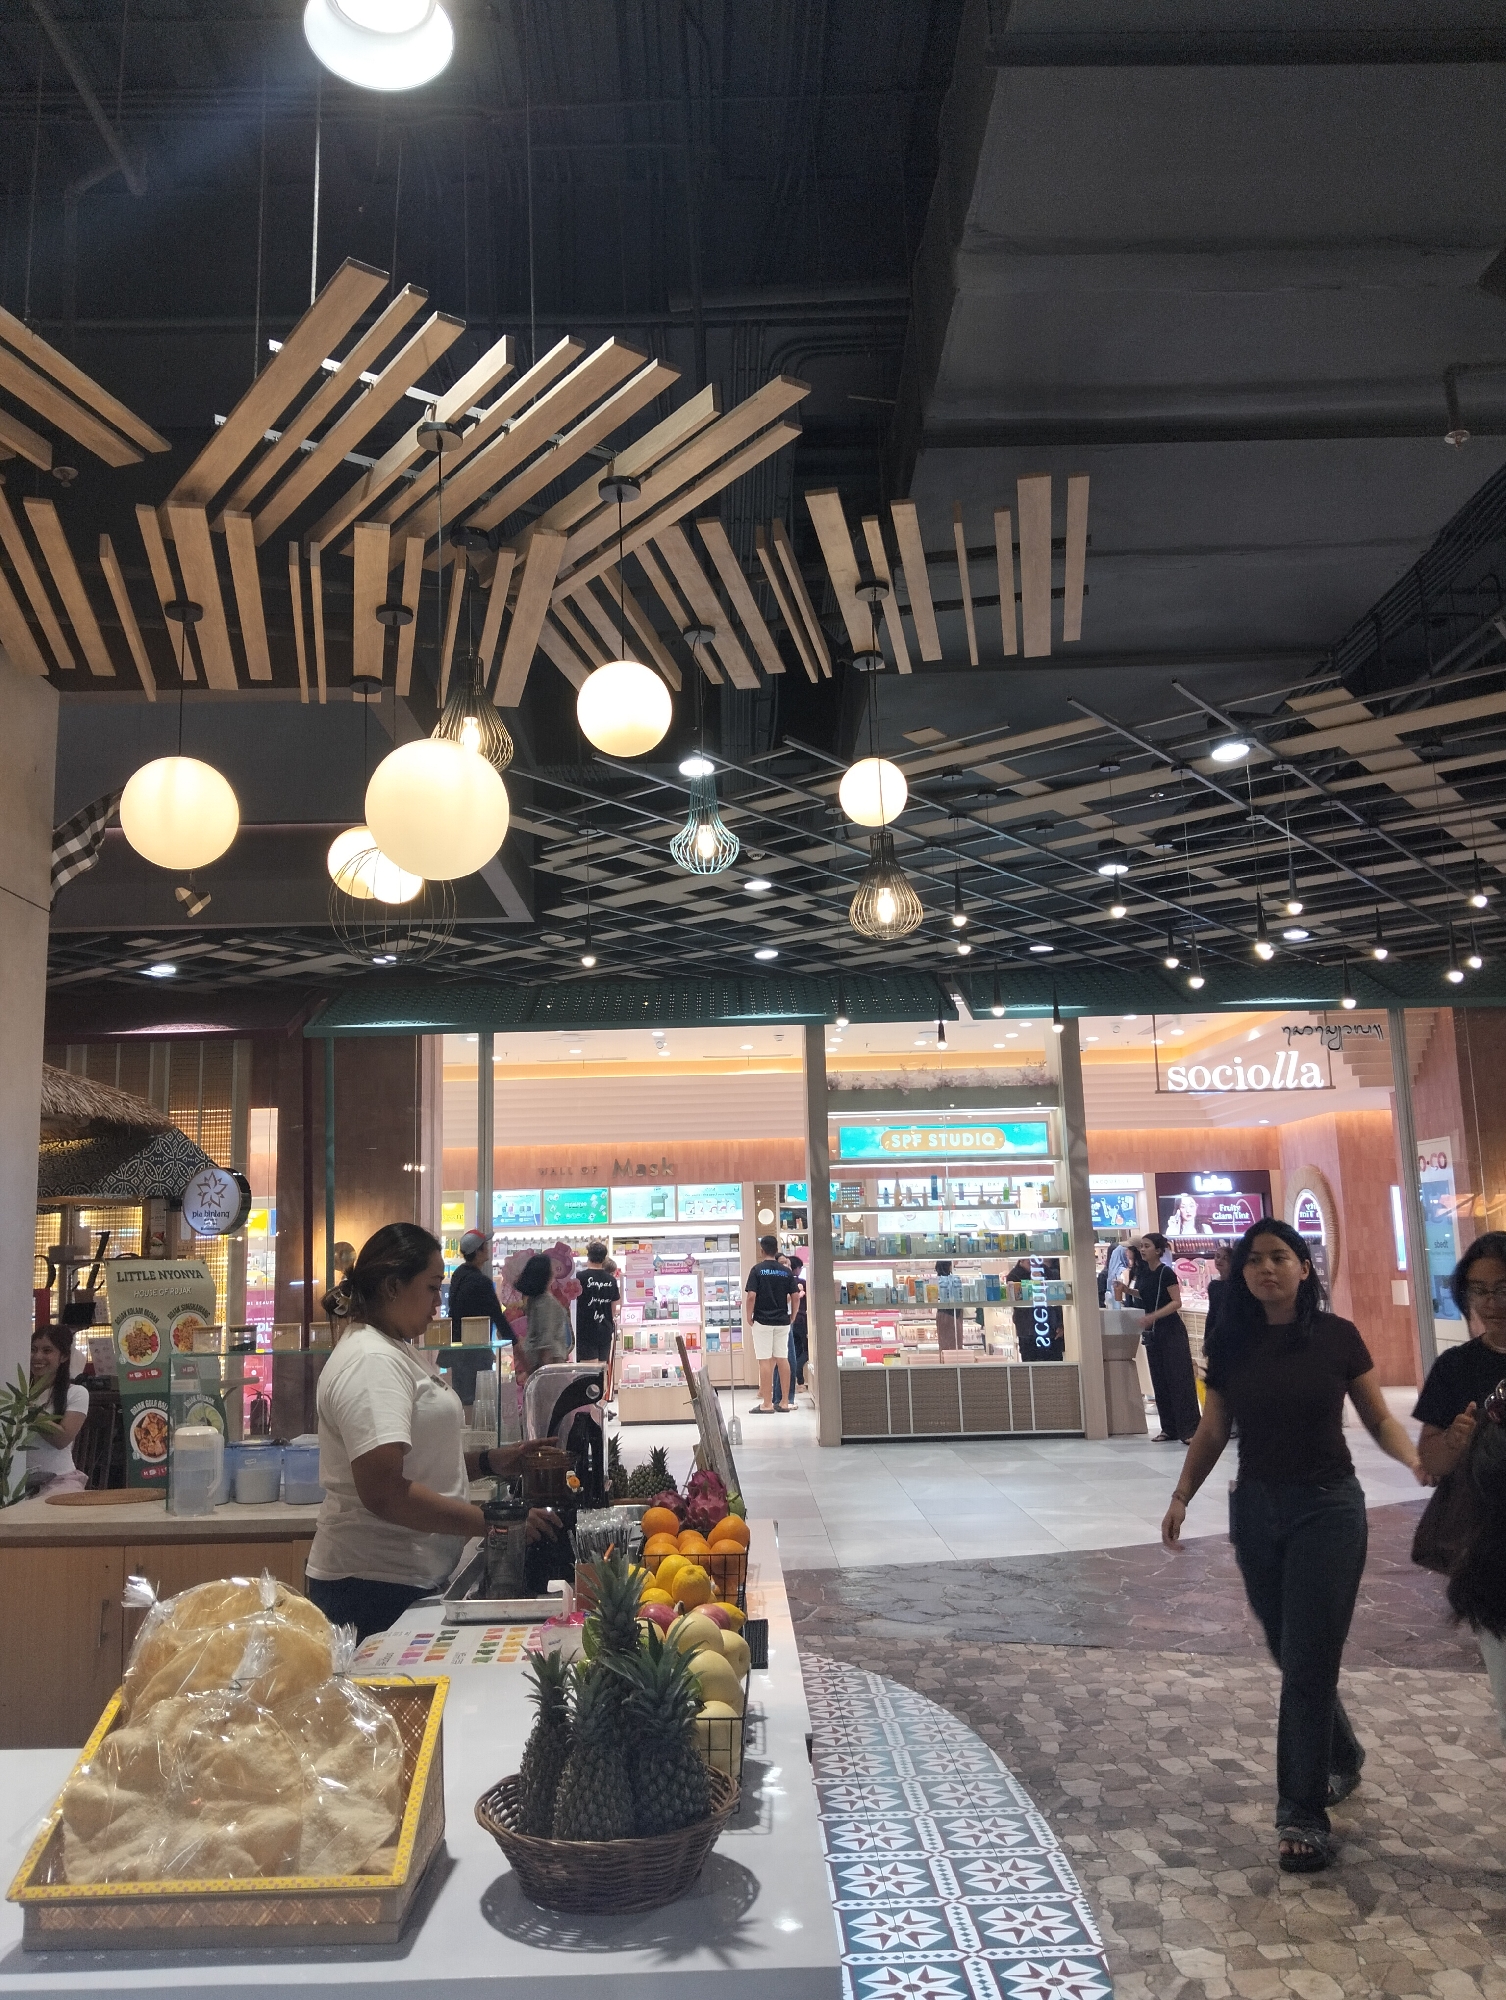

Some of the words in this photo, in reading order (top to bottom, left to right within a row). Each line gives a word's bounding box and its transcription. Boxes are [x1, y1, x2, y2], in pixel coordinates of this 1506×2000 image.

[1168, 1051, 1324, 1091] sociolla
[891, 1133, 922, 1148] SPF
[928, 1132, 996, 1147] STUDIO
[538, 1167, 574, 1176] WALL
[581, 1166, 598, 1175] OF
[612, 1156, 675, 1178] Mask
[192, 1209, 202, 1218] pia
[1219, 1203, 1241, 1212] Fruity
[1213, 1211, 1233, 1219] Glam
[116, 1271, 156, 1282] LITTLE
[159, 1269, 204, 1280] NYONYA
[134, 1289, 158, 1298] HOUSE
[160, 1288, 168, 1296] OF
[170, 1287, 191, 1296] ROJAK
